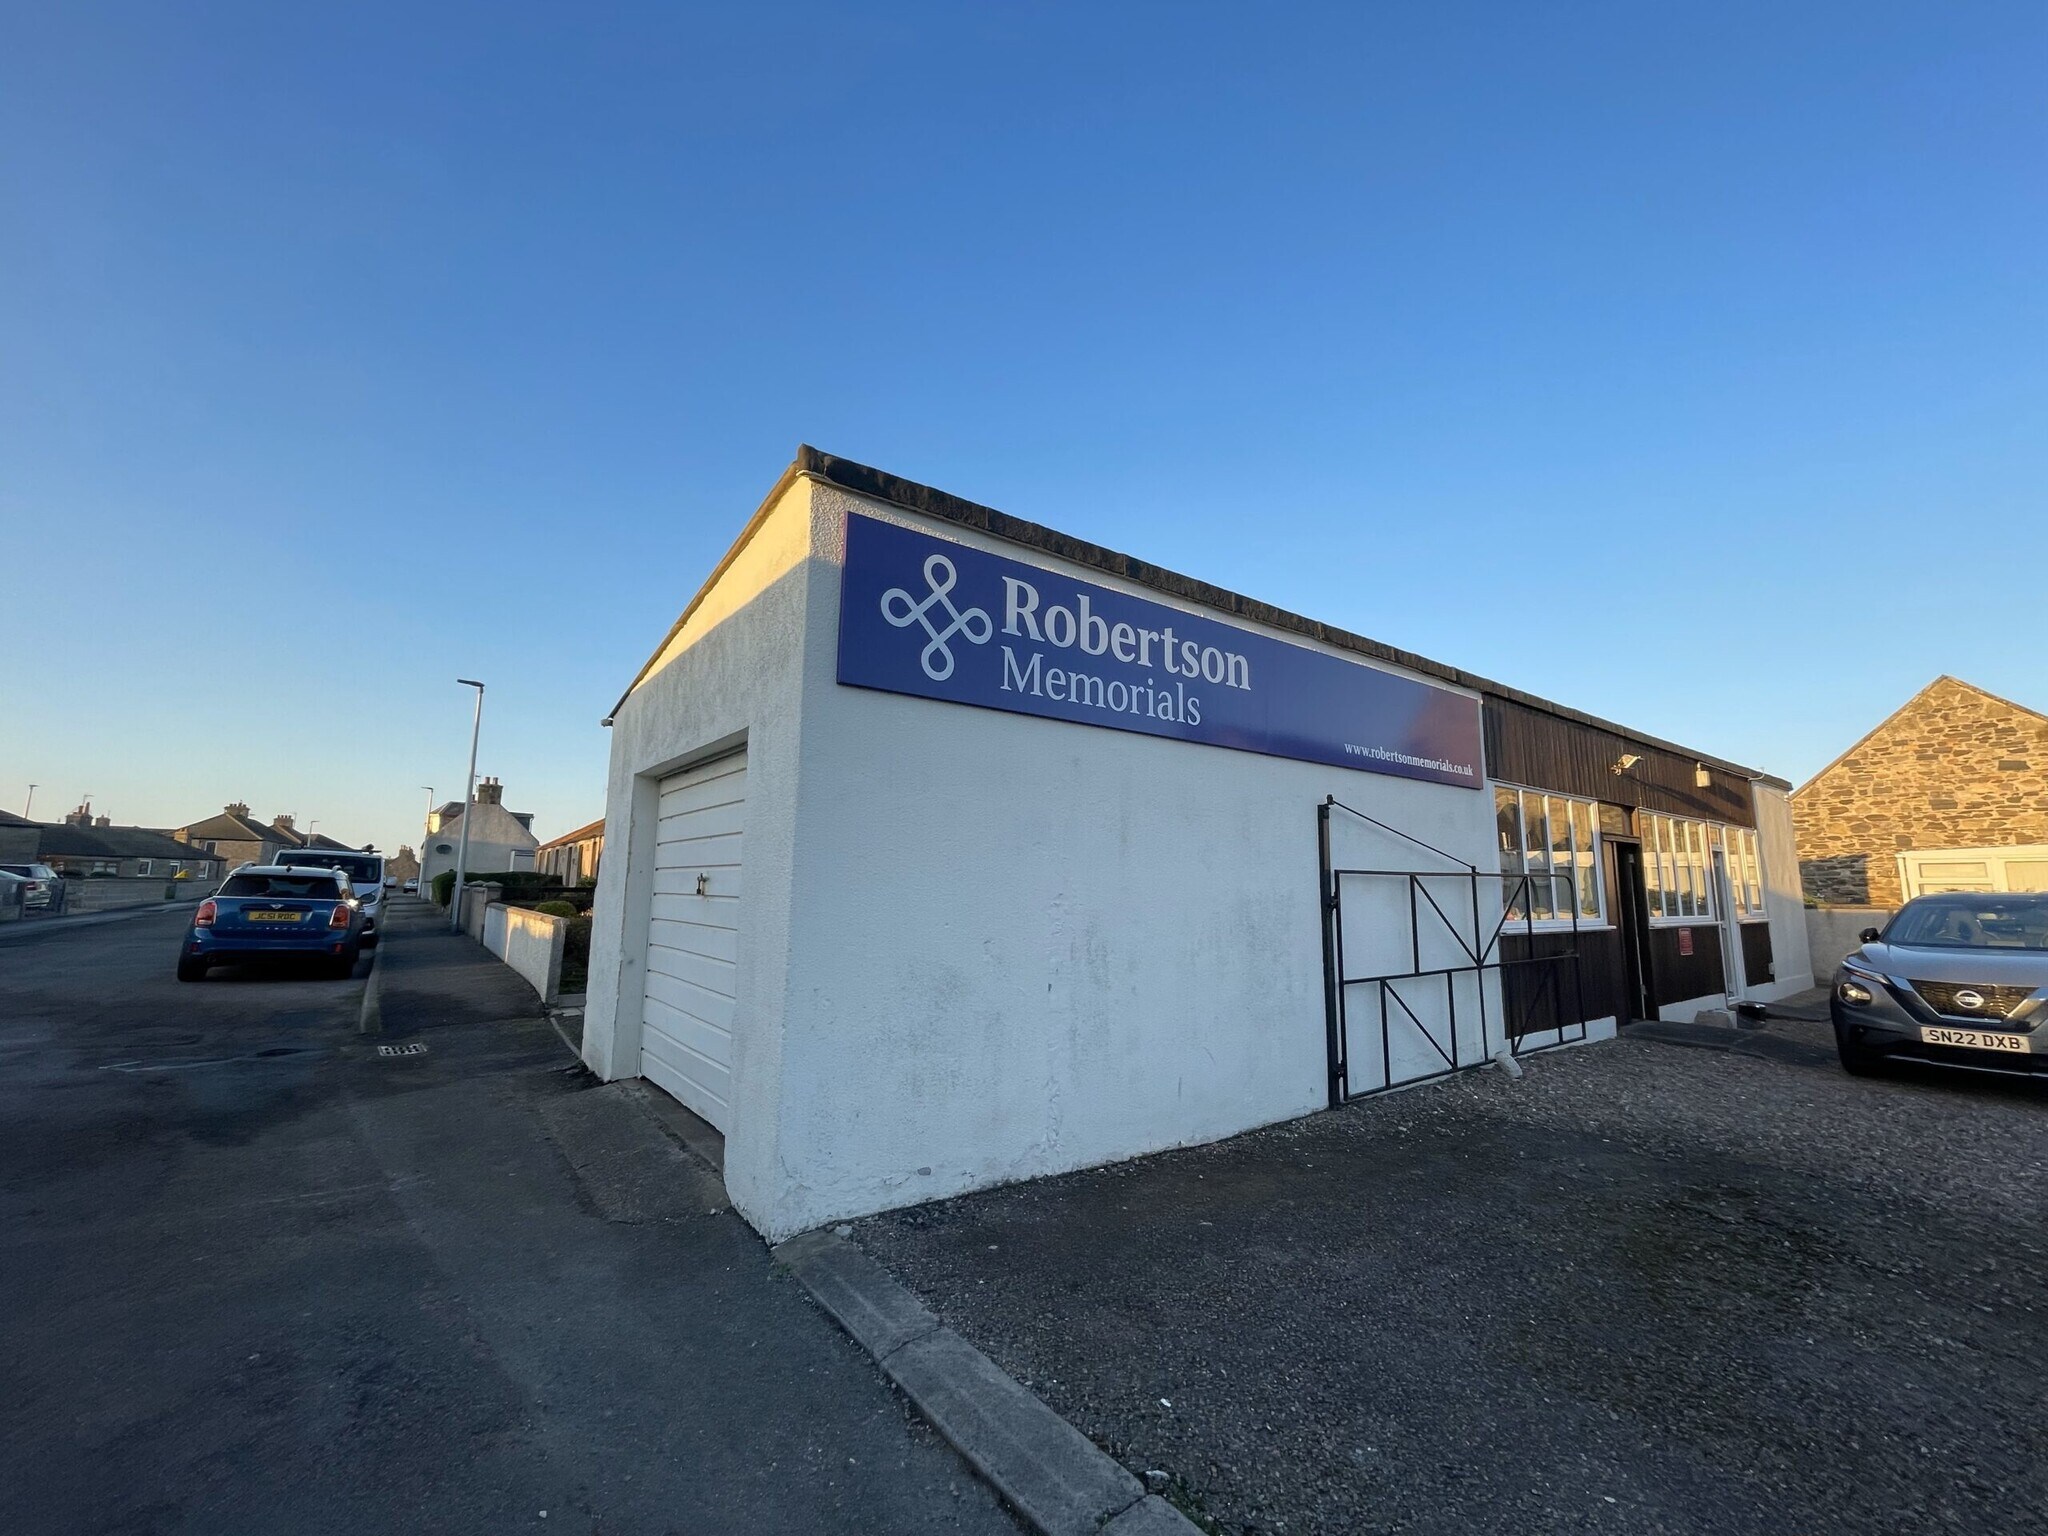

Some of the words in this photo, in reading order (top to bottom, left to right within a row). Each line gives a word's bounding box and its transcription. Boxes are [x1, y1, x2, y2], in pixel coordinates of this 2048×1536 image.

[1001, 576, 1251, 691] Robertson
[1000, 645, 1201, 726] Memorials
[1344, 743, 1474, 776] www.robertsonmemorials.co.uk
[1929, 1029, 1977, 1046] SN22
[1981, 1034, 2020, 1050] DXB
